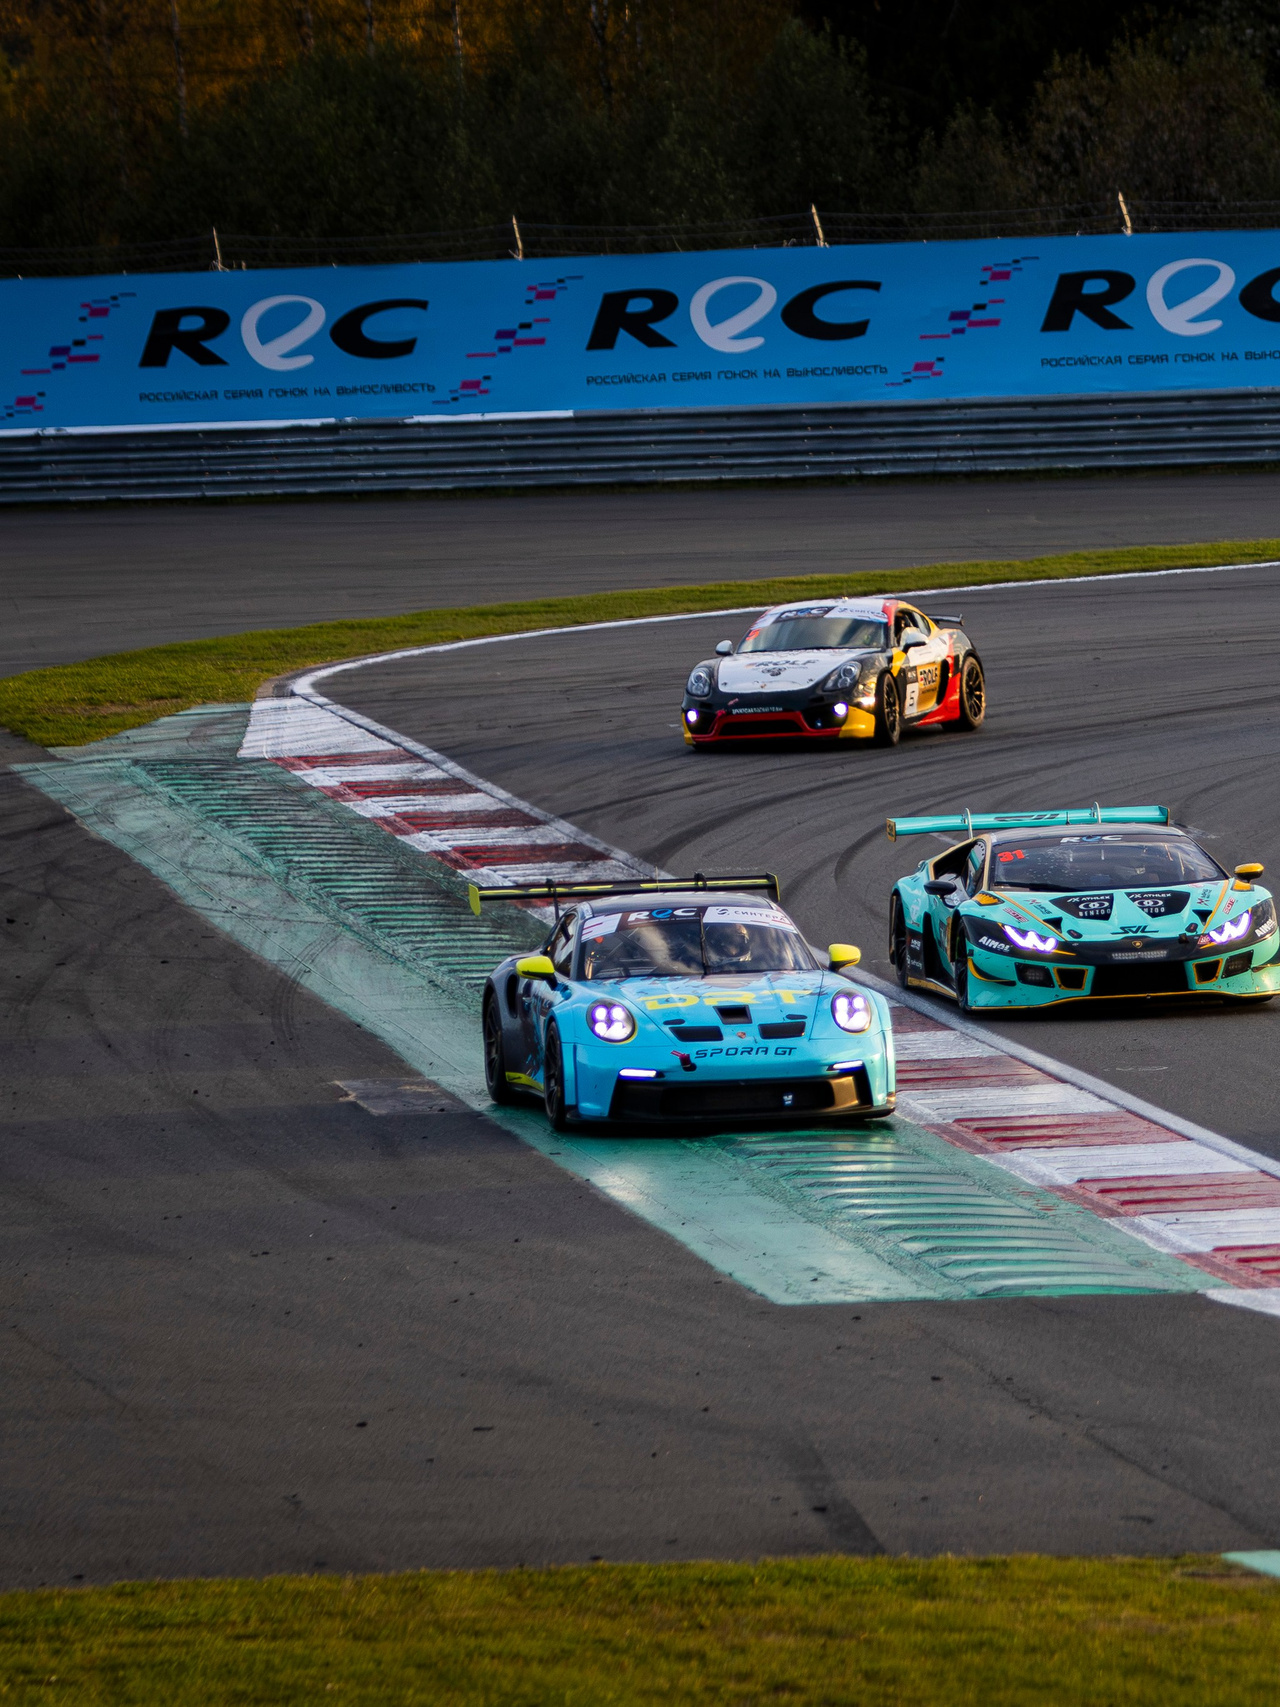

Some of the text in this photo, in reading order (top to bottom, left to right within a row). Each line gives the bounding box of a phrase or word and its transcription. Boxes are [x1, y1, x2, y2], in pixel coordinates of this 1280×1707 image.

[1041, 355, 1123, 368] РОССИЙСКАЯ
[1127, 354, 1169, 365] СЕРИЯ
[1174, 352, 1216, 364] ГОНОК
[1221, 352, 1239, 362] НА
[586, 364, 888, 386] РОССИЙСКАЯ СЕРИЯ ГОНОК НА ВЫНОСЛИВОСТЬ
[138, 383, 436, 402] РОССИЙСКАЯ СЕРИЯ ГОНОК НА ВЫНОСЛИВОСТЬ
[997, 849, 1025, 862] 31
[638, 989, 814, 1011] DRT
[694, 1046, 798, 1060] SPORA GT
